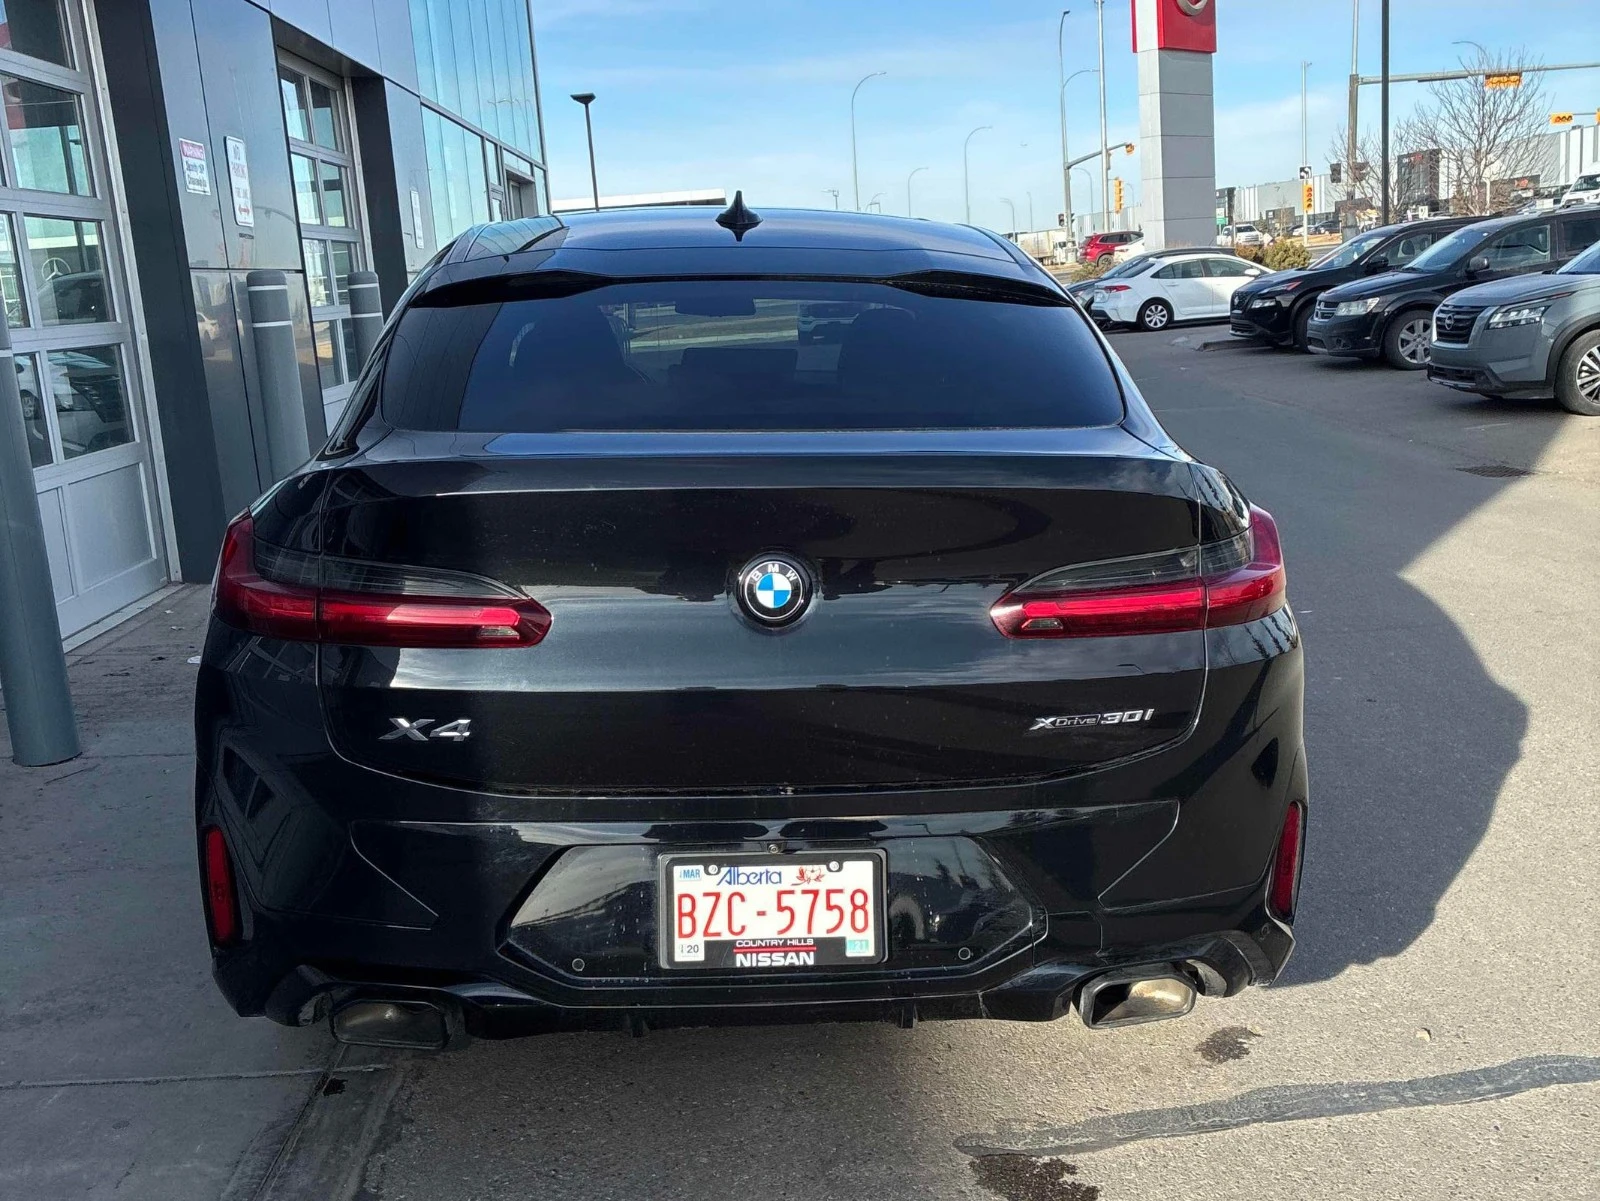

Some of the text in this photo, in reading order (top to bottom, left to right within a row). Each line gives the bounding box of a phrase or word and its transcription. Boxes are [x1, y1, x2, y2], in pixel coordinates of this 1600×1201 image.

[751, 563, 797, 582] BMW
[378, 718, 471, 741] X4
[683, 869, 701, 878] MAR
[717, 867, 782, 886] Alberta
[677, 889, 869, 938] BZC-5758
[686, 945, 699, 953] 20
[736, 938, 813, 948] COUNTRY HILLS
[736, 952, 814, 967] NISSAN
